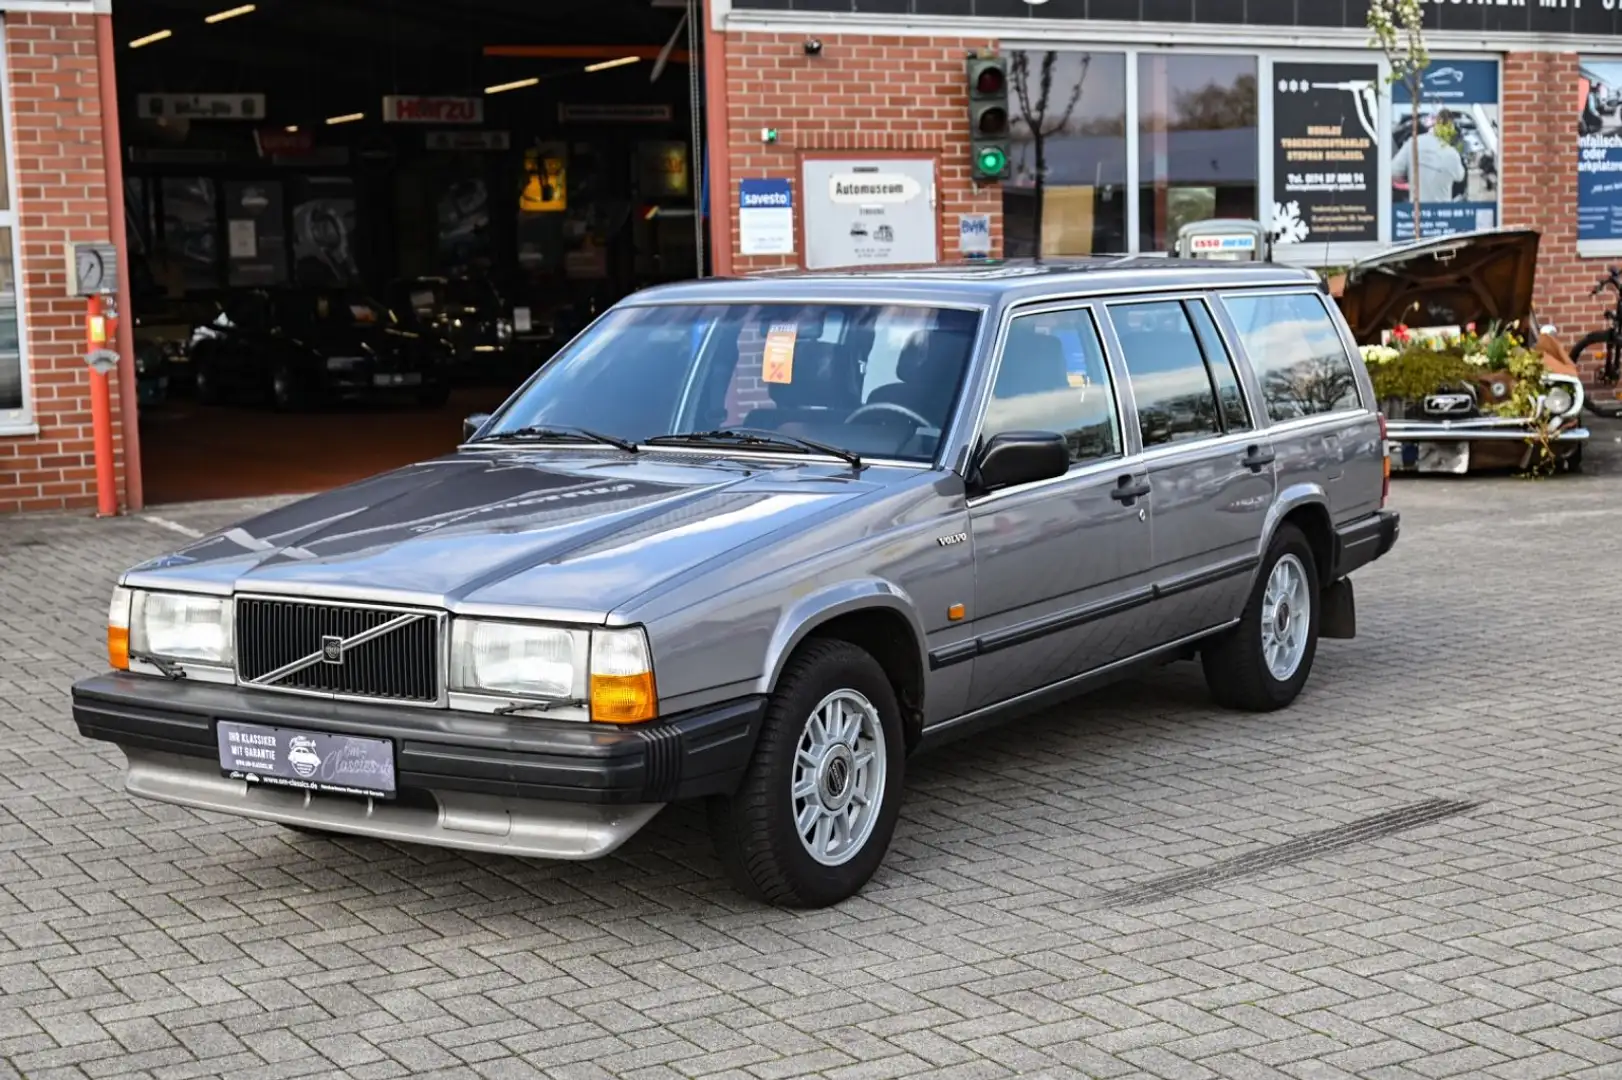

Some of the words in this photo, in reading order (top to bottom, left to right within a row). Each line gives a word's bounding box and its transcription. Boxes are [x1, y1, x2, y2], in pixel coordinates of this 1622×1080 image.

[1582, 148, 1607, 160] oder
[836, 182, 904, 196] Automuseum
[745, 193, 787, 205] savesto
[937, 533, 967, 546] VOLVO
[228, 731, 241, 743] IHR
[241, 733, 277, 747] KLASSIKER
[231, 745, 243, 756] MIT
[244, 746, 276, 761] GARANTIE
